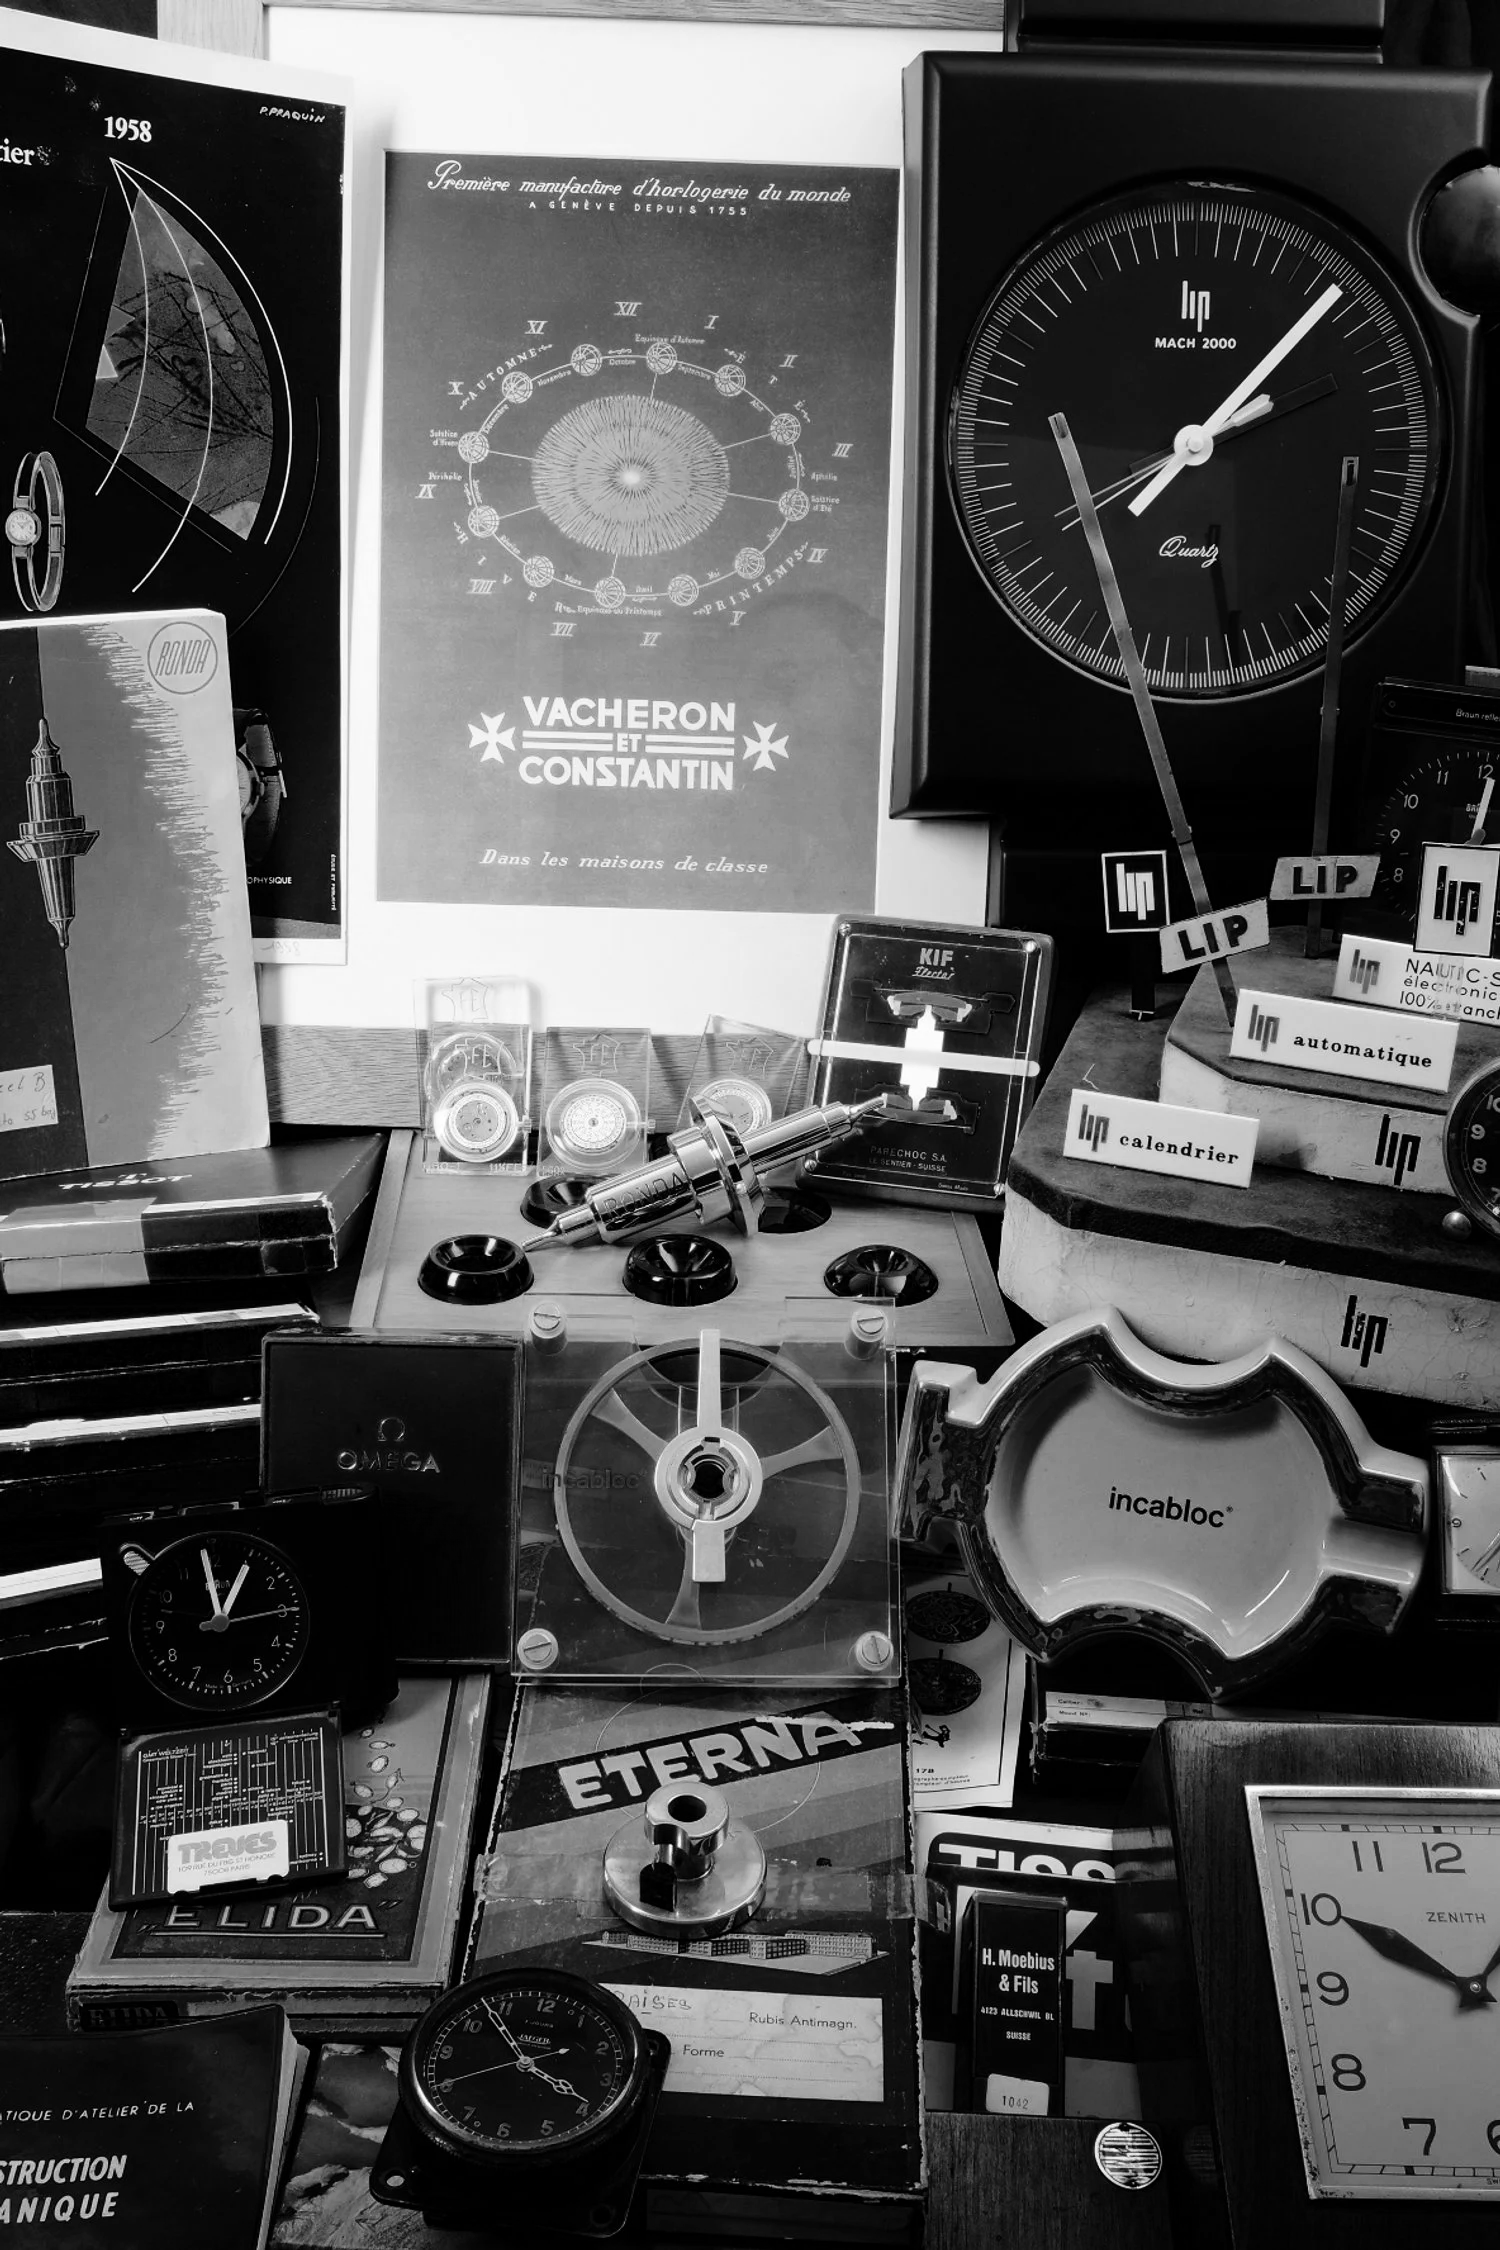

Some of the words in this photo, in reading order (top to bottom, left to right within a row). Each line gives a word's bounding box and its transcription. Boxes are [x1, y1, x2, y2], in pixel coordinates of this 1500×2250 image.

[103, 115, 152, 143] 1958
[427, 160, 511, 191] Première
[518, 176, 623, 201] manufacture
[632, 178, 749, 202] d'horlogerie
[758, 184, 782, 200] du
[786, 187, 852, 202] monde
[529, 201, 536, 209] A
[634, 203, 697, 215] DEPUIS
[708, 206, 747, 216] 1755
[614, 301, 642, 316] XII
[1180, 279, 1211, 333] lip
[525, 320, 549, 334] XI
[704, 315, 719, 329] I
[1154, 337, 1197, 350] MACH
[1201, 337, 1238, 351] 2000
[779, 354, 799, 368] II
[468, 348, 537, 400] AUTOMNE
[448, 381, 464, 396] X
[832, 443, 853, 457] III
[415, 483, 437, 499] IX
[807, 548, 828, 563] IV
[1158, 535, 1220, 568] Quartz
[466, 578, 497, 594] VIII
[703, 549, 803, 615] PRINTEMPS
[730, 611, 746, 626] V
[550, 622, 577, 637] VII
[640, 631, 662, 646] VI
[155, 640, 209, 675] RONDA
[522, 695, 736, 732] VACHERON
[1455, 707, 1480, 719] Braun
[616, 733, 642, 753] ET
[518, 755, 734, 791] CONSTANTIN
[1435, 769, 1450, 786] 11
[1477, 763, 1495, 780] 12
[1403, 793, 1420, 810] 10
[1389, 827, 1401, 845] 9
[479, 848, 531, 866] Dans
[541, 850, 568, 867] les
[578, 853, 665, 871] maisons
[674, 854, 698, 872] de
[704, 856, 769, 874] classe
[1291, 865, 1357, 895] LIP
[1392, 866, 1405, 884] 8
[1115, 863, 1154, 921] lip
[1176, 912, 1249, 961] LIP
[919, 947, 954, 967] KIF
[1349, 948, 1381, 994] lip
[1248, 1004, 1280, 1052] lip
[1292, 1033, 1432, 1069] automatique
[1078, 1104, 1110, 1152] lip
[1118, 1128, 1239, 1166] calendrier
[1470, 1123, 1486, 1140] 9
[870, 1145, 927, 1160] PARECHOC
[1375, 1113, 1421, 1186] lip
[880, 1158, 911, 1168] SENTIER
[918, 1163, 947, 1173] SUISSE
[1471, 1157, 1487, 1174] 8
[58, 1174, 193, 1190] TISSOT
[604, 1171, 689, 1221] RONDA
[336, 1449, 441, 1474] OMEGA
[178, 1566, 191, 1582] 11
[265, 1576, 277, 1591] 2
[158, 1589, 173, 1605] 10
[155, 1619, 166, 1635] 9
[270, 1634, 281, 1649] 4
[168, 1648, 178, 1664] 8
[191, 1665, 202, 1680] 7
[252, 1658, 263, 1673] 5
[223, 1668, 233, 1684] 6
[557, 1711, 862, 1810] ETERNA
[178, 1831, 277, 1865] TREVES
[1351, 1840, 1384, 1872] 11
[1421, 1841, 1466, 1874] 12
[1300, 1892, 1342, 1926] 10
[1425, 1911, 1486, 1924] ZENITH
[982, 1947, 996, 1967] H.
[998, 1949, 1055, 1971] Moebius
[998, 1973, 1013, 1996] &
[1014, 1974, 1039, 1996] Fils
[1316, 1970, 1350, 2006] 9
[498, 2001, 513, 2016] 11
[536, 1998, 556, 2014] 12
[462, 2018, 484, 2034] 10
[576, 2014, 586, 2028] 1
[749, 2011, 785, 2026] Rubis
[789, 2012, 857, 2030] Antimagn.
[1005, 2029, 1032, 2041] SUISSE
[439, 2044, 454, 2060] 9
[594, 2041, 610, 2056] 2
[682, 2044, 724, 2058] Forme
[599, 2072, 613, 2087] 3
[1331, 2052, 1366, 2092] 8
[62, 2104, 139, 2121] D'ATELIER
[147, 2101, 168, 2116] DE
[176, 2100, 196, 2113] LA
[575, 2101, 590, 2117] 4
[1001, 2094, 1030, 2110] 1042
[463, 2104, 477, 2122] 7
[496, 2121, 512, 2138] 6
[540, 2119, 555, 2137] 5
[1402, 2117, 1437, 2156] 7
[0, 2154, 128, 2187] STRUCTION
[0, 2191, 119, 2225] ANIQUE
